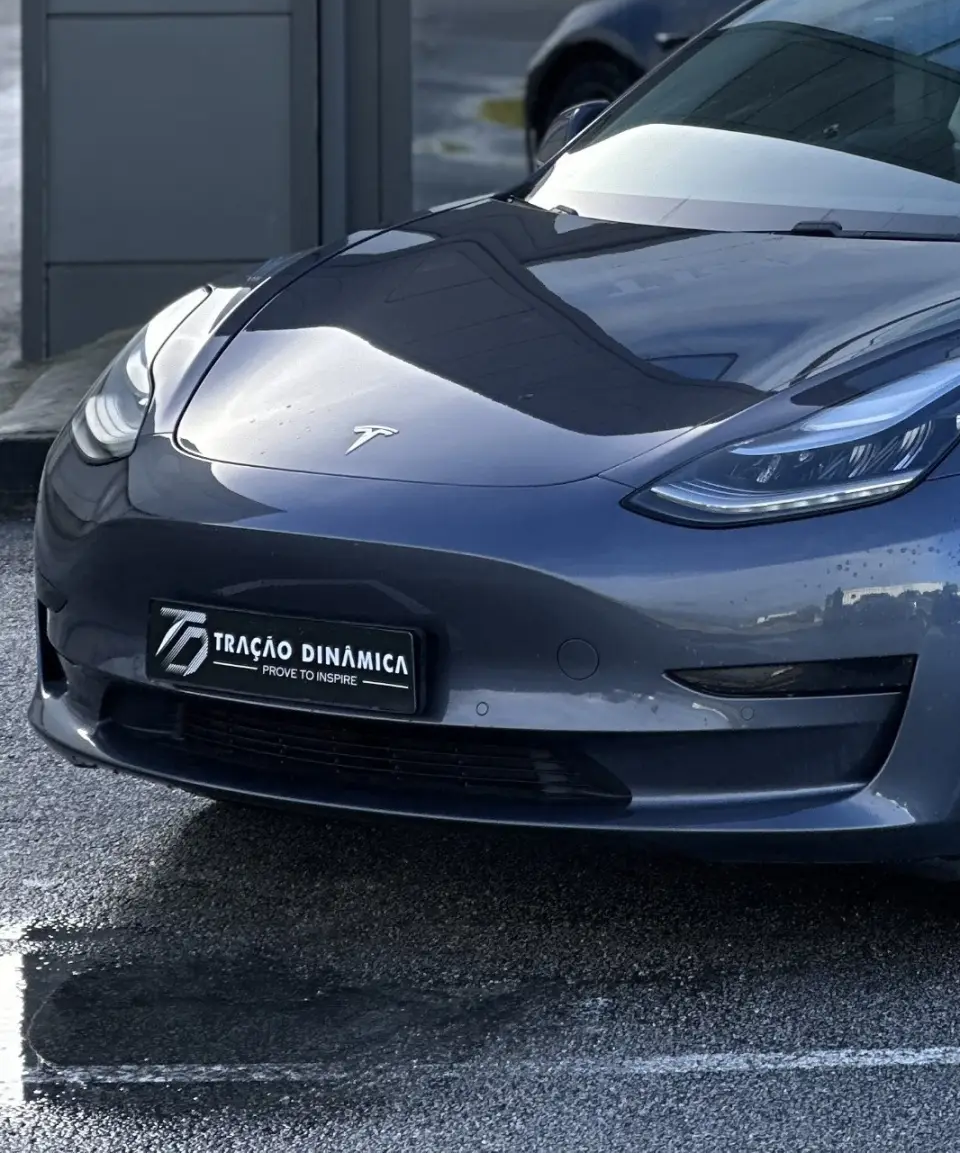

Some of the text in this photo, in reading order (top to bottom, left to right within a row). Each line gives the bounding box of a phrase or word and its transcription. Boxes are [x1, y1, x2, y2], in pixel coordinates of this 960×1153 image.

[213, 632, 408, 675] TRAÇÃO DINÂMICA
[262, 665, 358, 686] PROVE TO INSPIRE
